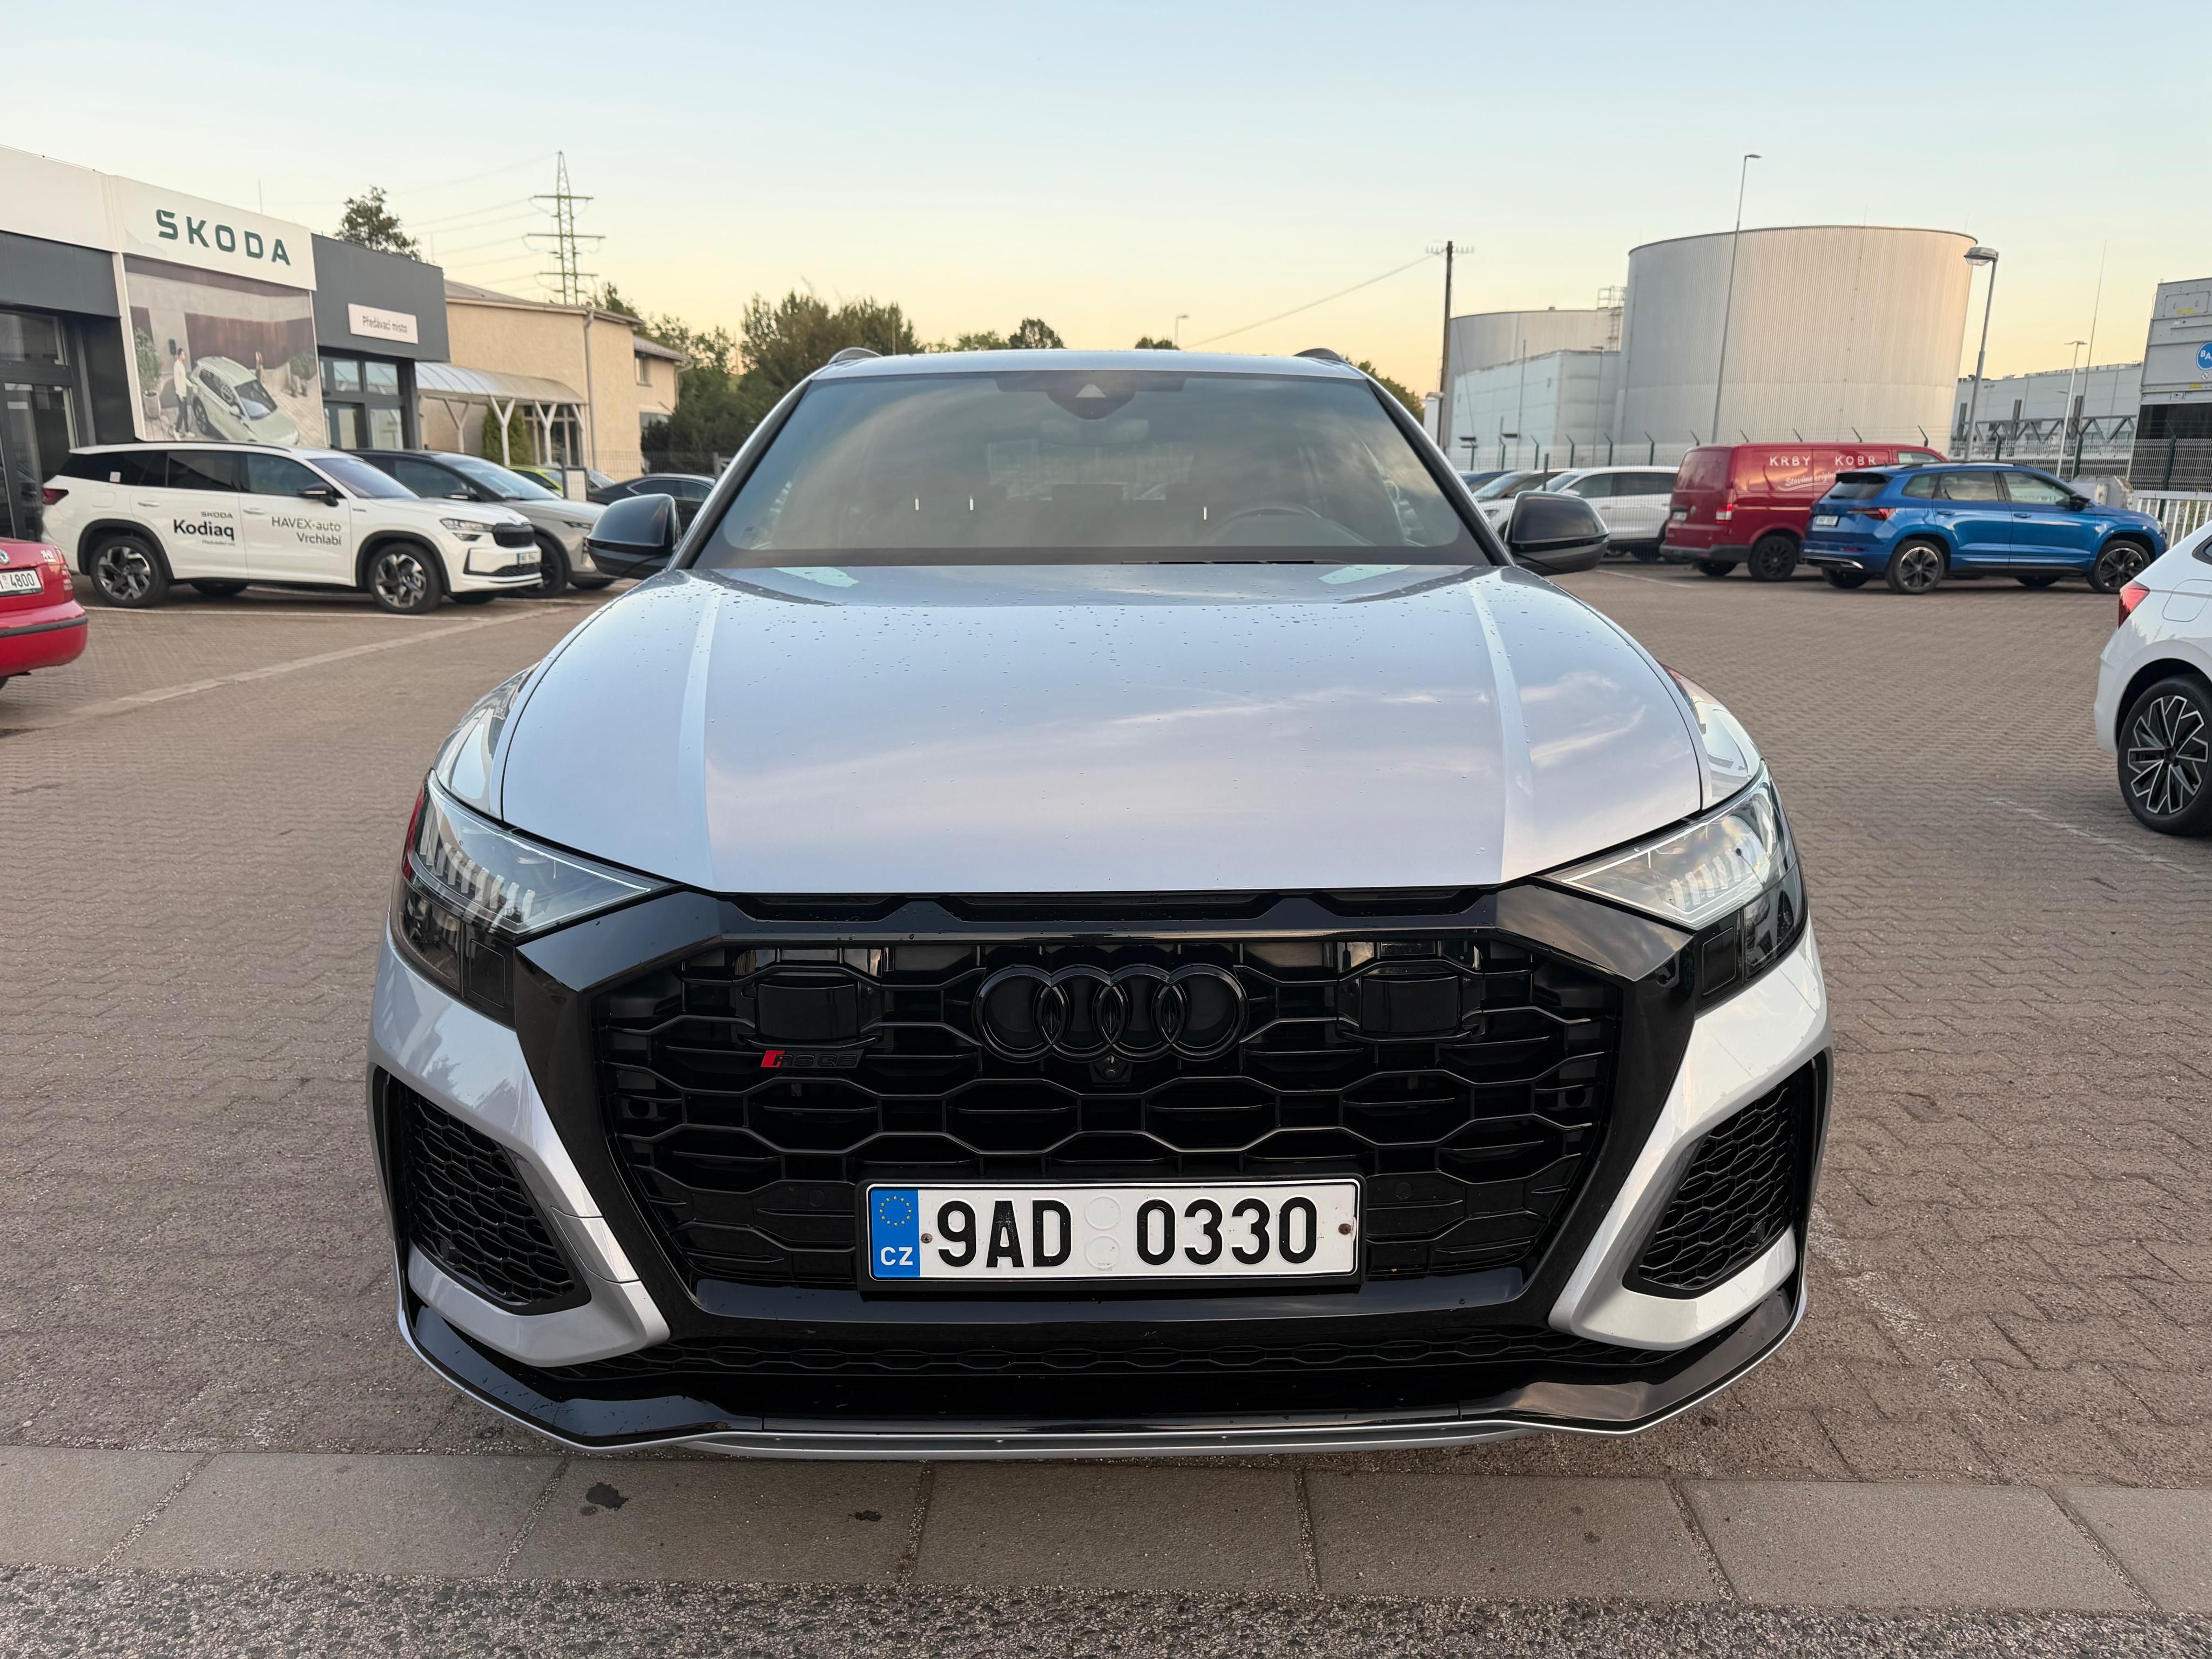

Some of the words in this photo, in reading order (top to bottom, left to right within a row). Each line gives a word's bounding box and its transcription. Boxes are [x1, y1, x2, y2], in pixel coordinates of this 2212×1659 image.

[2201, 350, 2212, 361] BA
[1770, 455, 1810, 466] KRBY
[1835, 455, 1877, 466] KOBR
[173, 519, 234, 541] Kodiaq
[272, 516, 341, 532] HAVEX-auto
[10, 573, 35, 588] 4800
[938, 1200, 1071, 1267] 9AD
[1137, 1197, 1317, 1265] 0330
[881, 1246, 913, 1266] CZ
